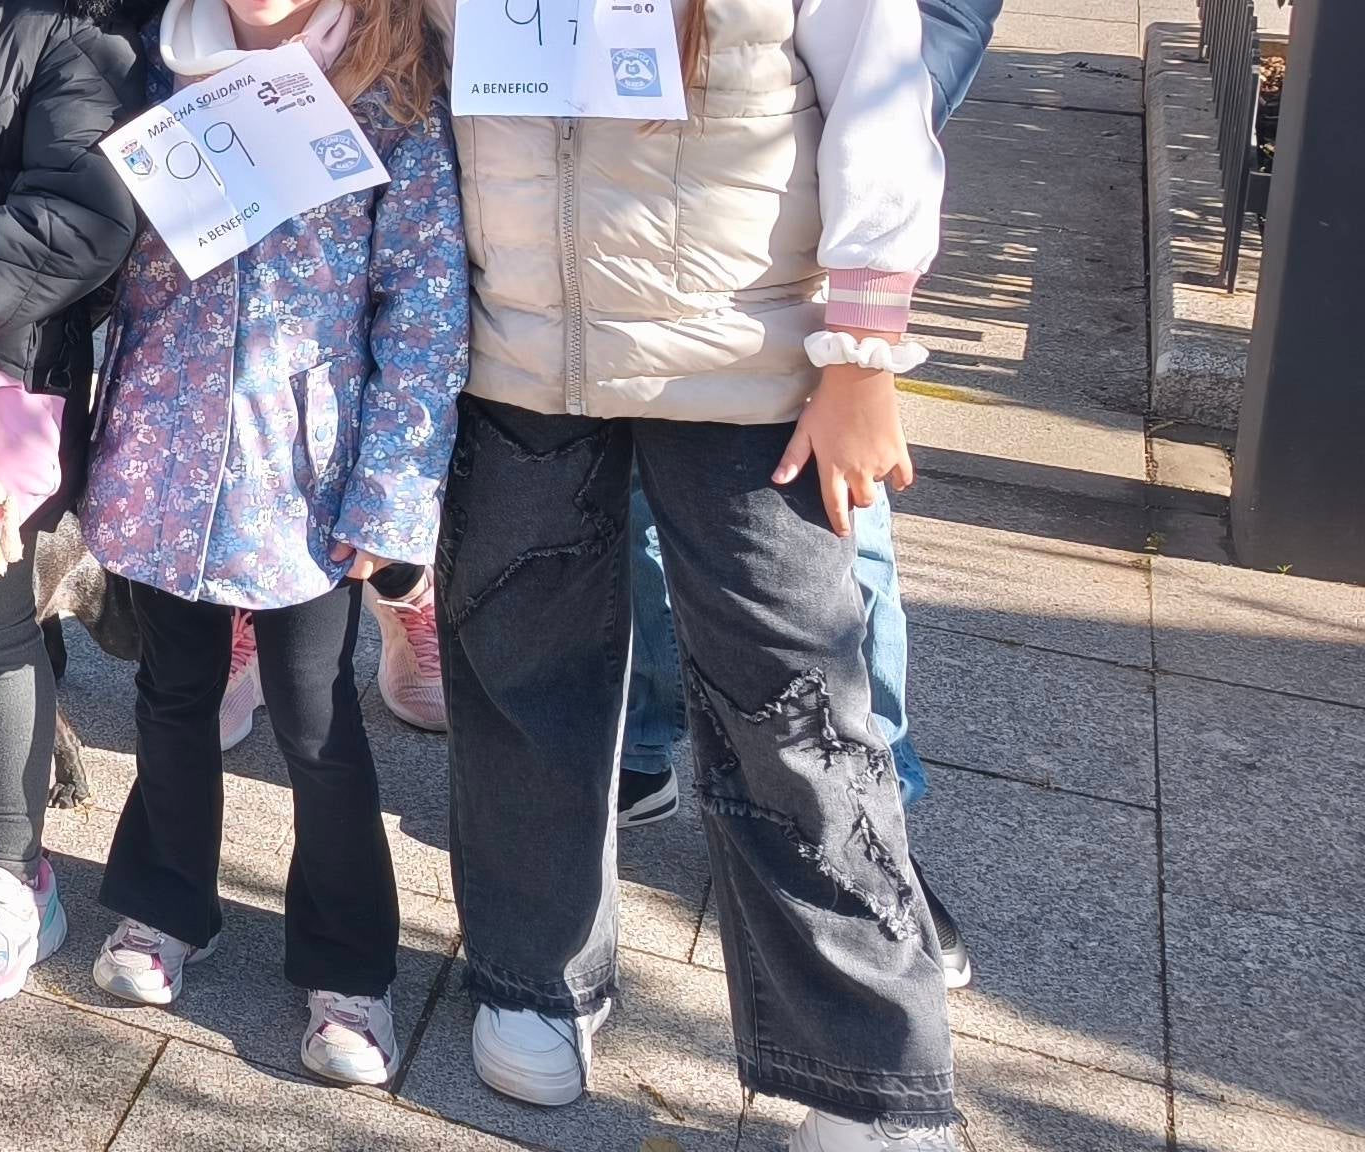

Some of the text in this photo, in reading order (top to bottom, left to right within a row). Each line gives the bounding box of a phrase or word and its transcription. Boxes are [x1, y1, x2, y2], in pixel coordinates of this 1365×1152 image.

[147, 105, 196, 140] MARCHA
[196, 74, 257, 109] SOLIDARIA
[471, 82, 549, 94] A BENEFICIO
[164, 121, 256, 187] 99
[197, 202, 261, 248] A BENEFICIO
